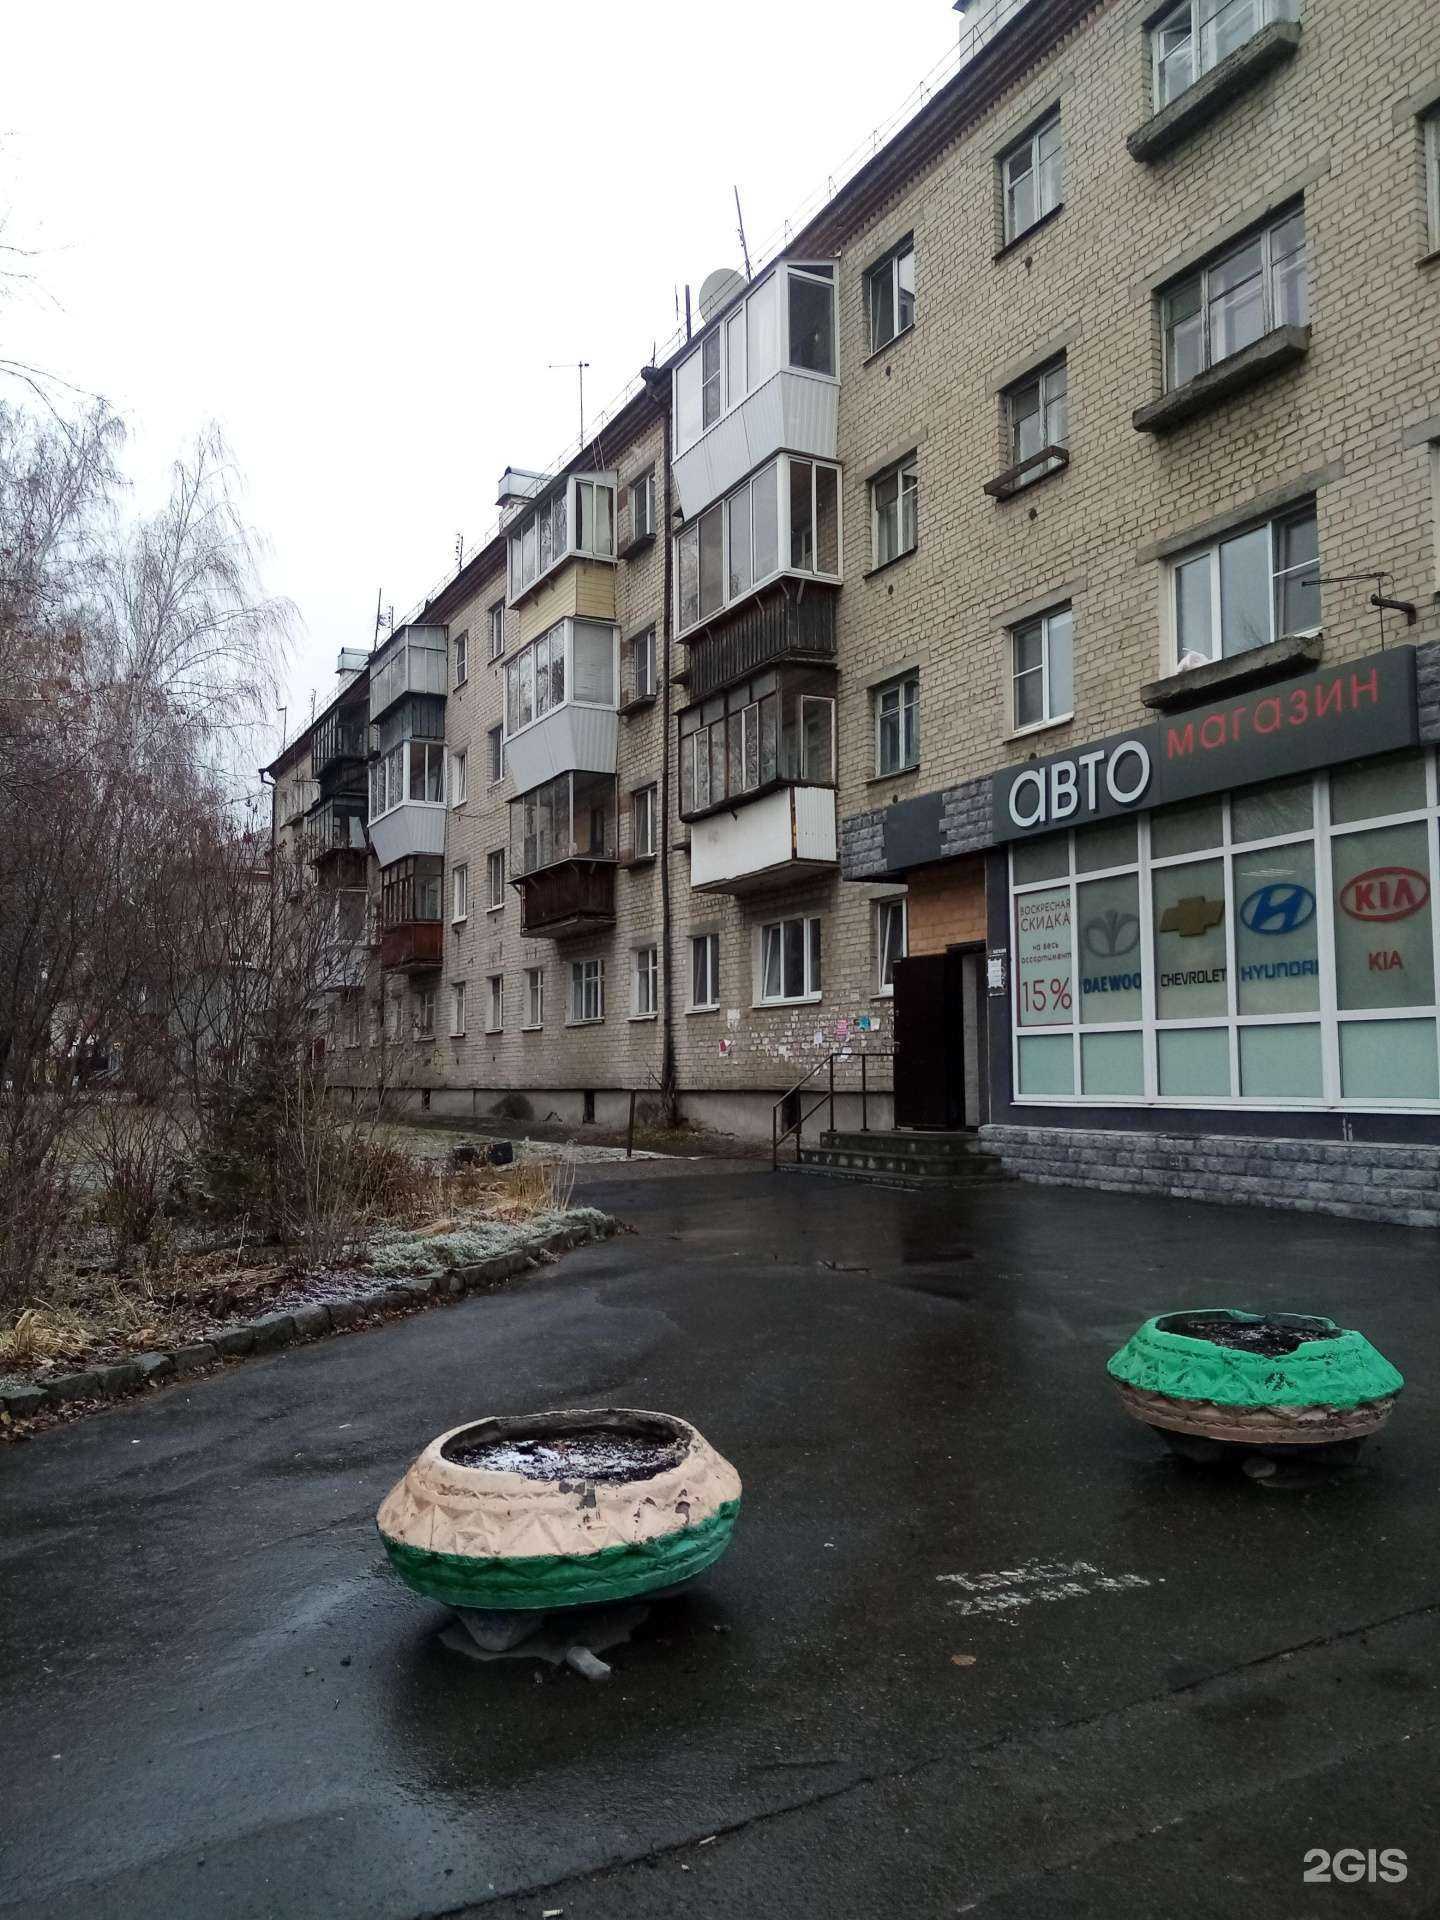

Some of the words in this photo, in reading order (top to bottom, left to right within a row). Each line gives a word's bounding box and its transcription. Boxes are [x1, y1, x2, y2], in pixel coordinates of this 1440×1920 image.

[1166, 668, 1379, 758] магазин
[1020, 912, 1071, 932] СКИДКА
[1368, 950, 1403, 971] KIA
[1082, 972, 1141, 994] DAEWOO
[1160, 968, 1226, 988] CHEVROLET
[1022, 976, 1073, 1012] 15%
